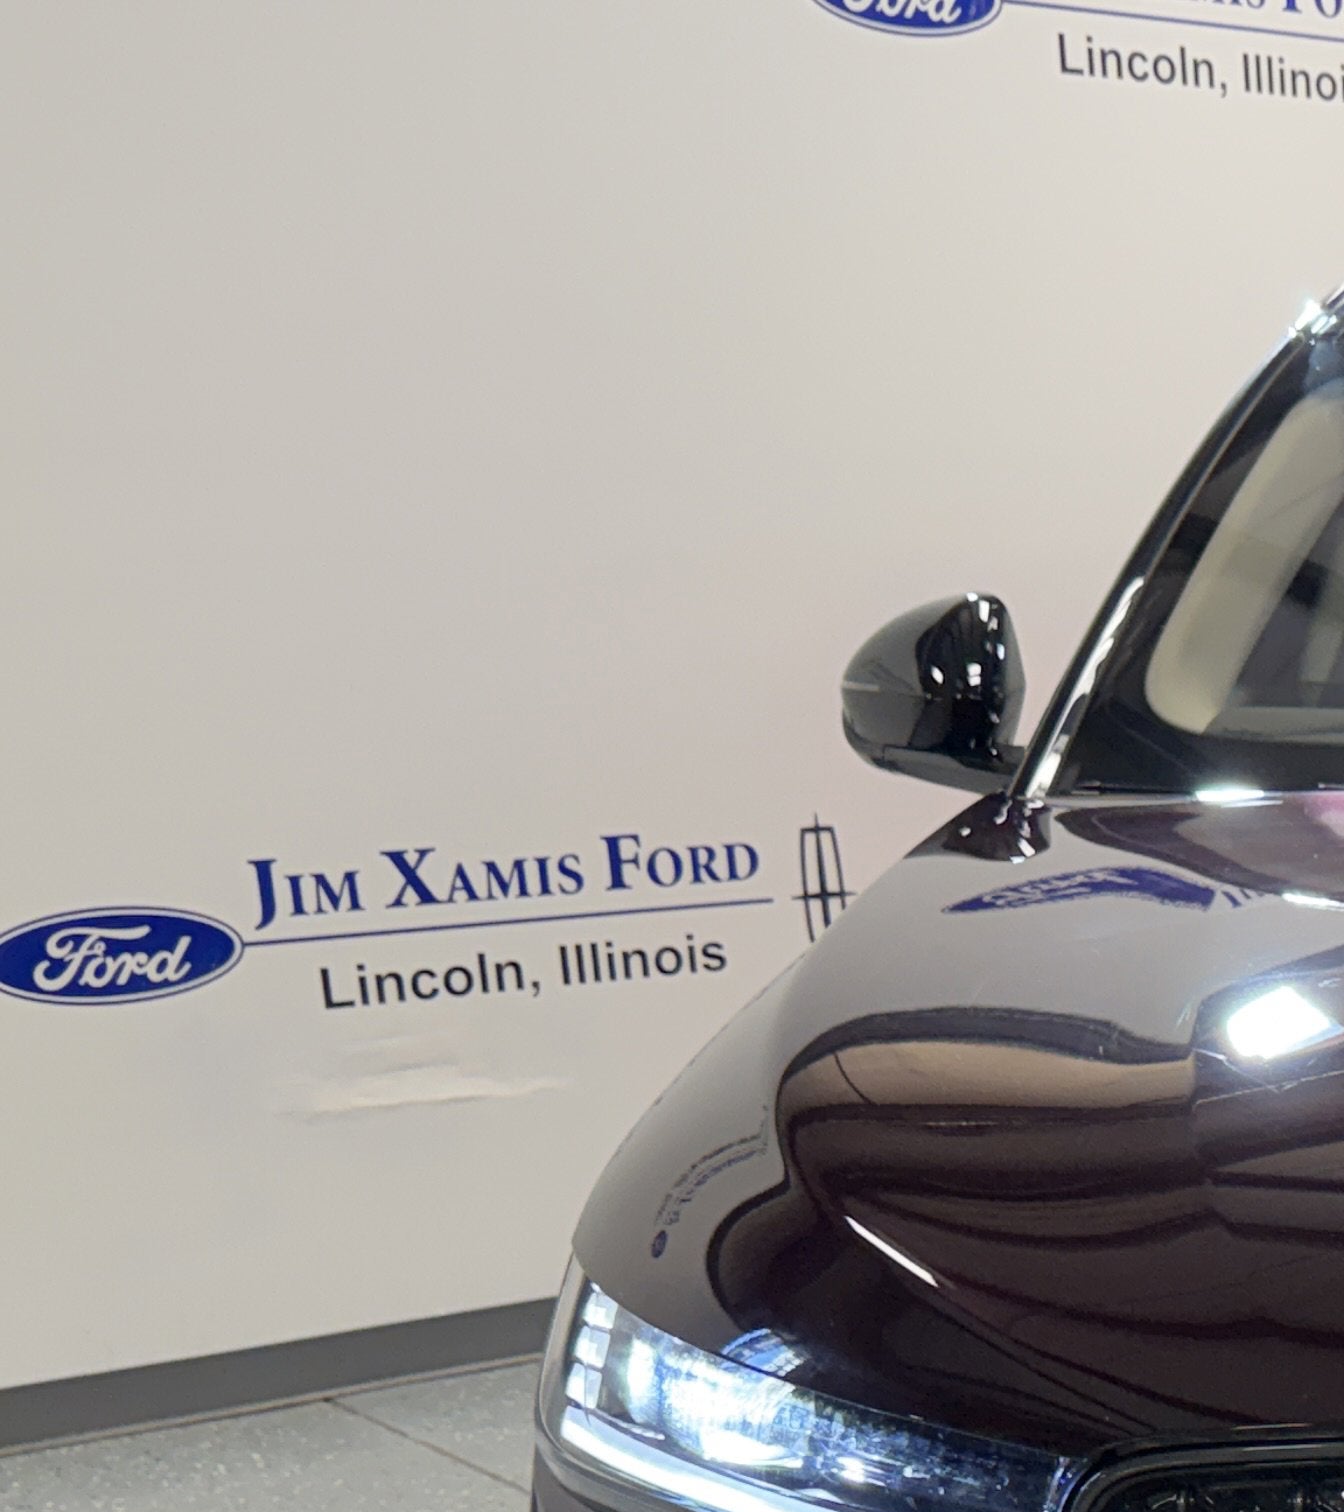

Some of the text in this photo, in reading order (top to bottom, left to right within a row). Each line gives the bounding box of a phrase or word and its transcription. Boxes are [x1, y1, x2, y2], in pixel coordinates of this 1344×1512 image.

[1057, 32, 1227, 97] Lincoln,
[248, 834, 759, 930] JIM XAMIS FORD
[32, 924, 192, 992] Ford
[320, 934, 727, 1010] Lincoln, Illinois
